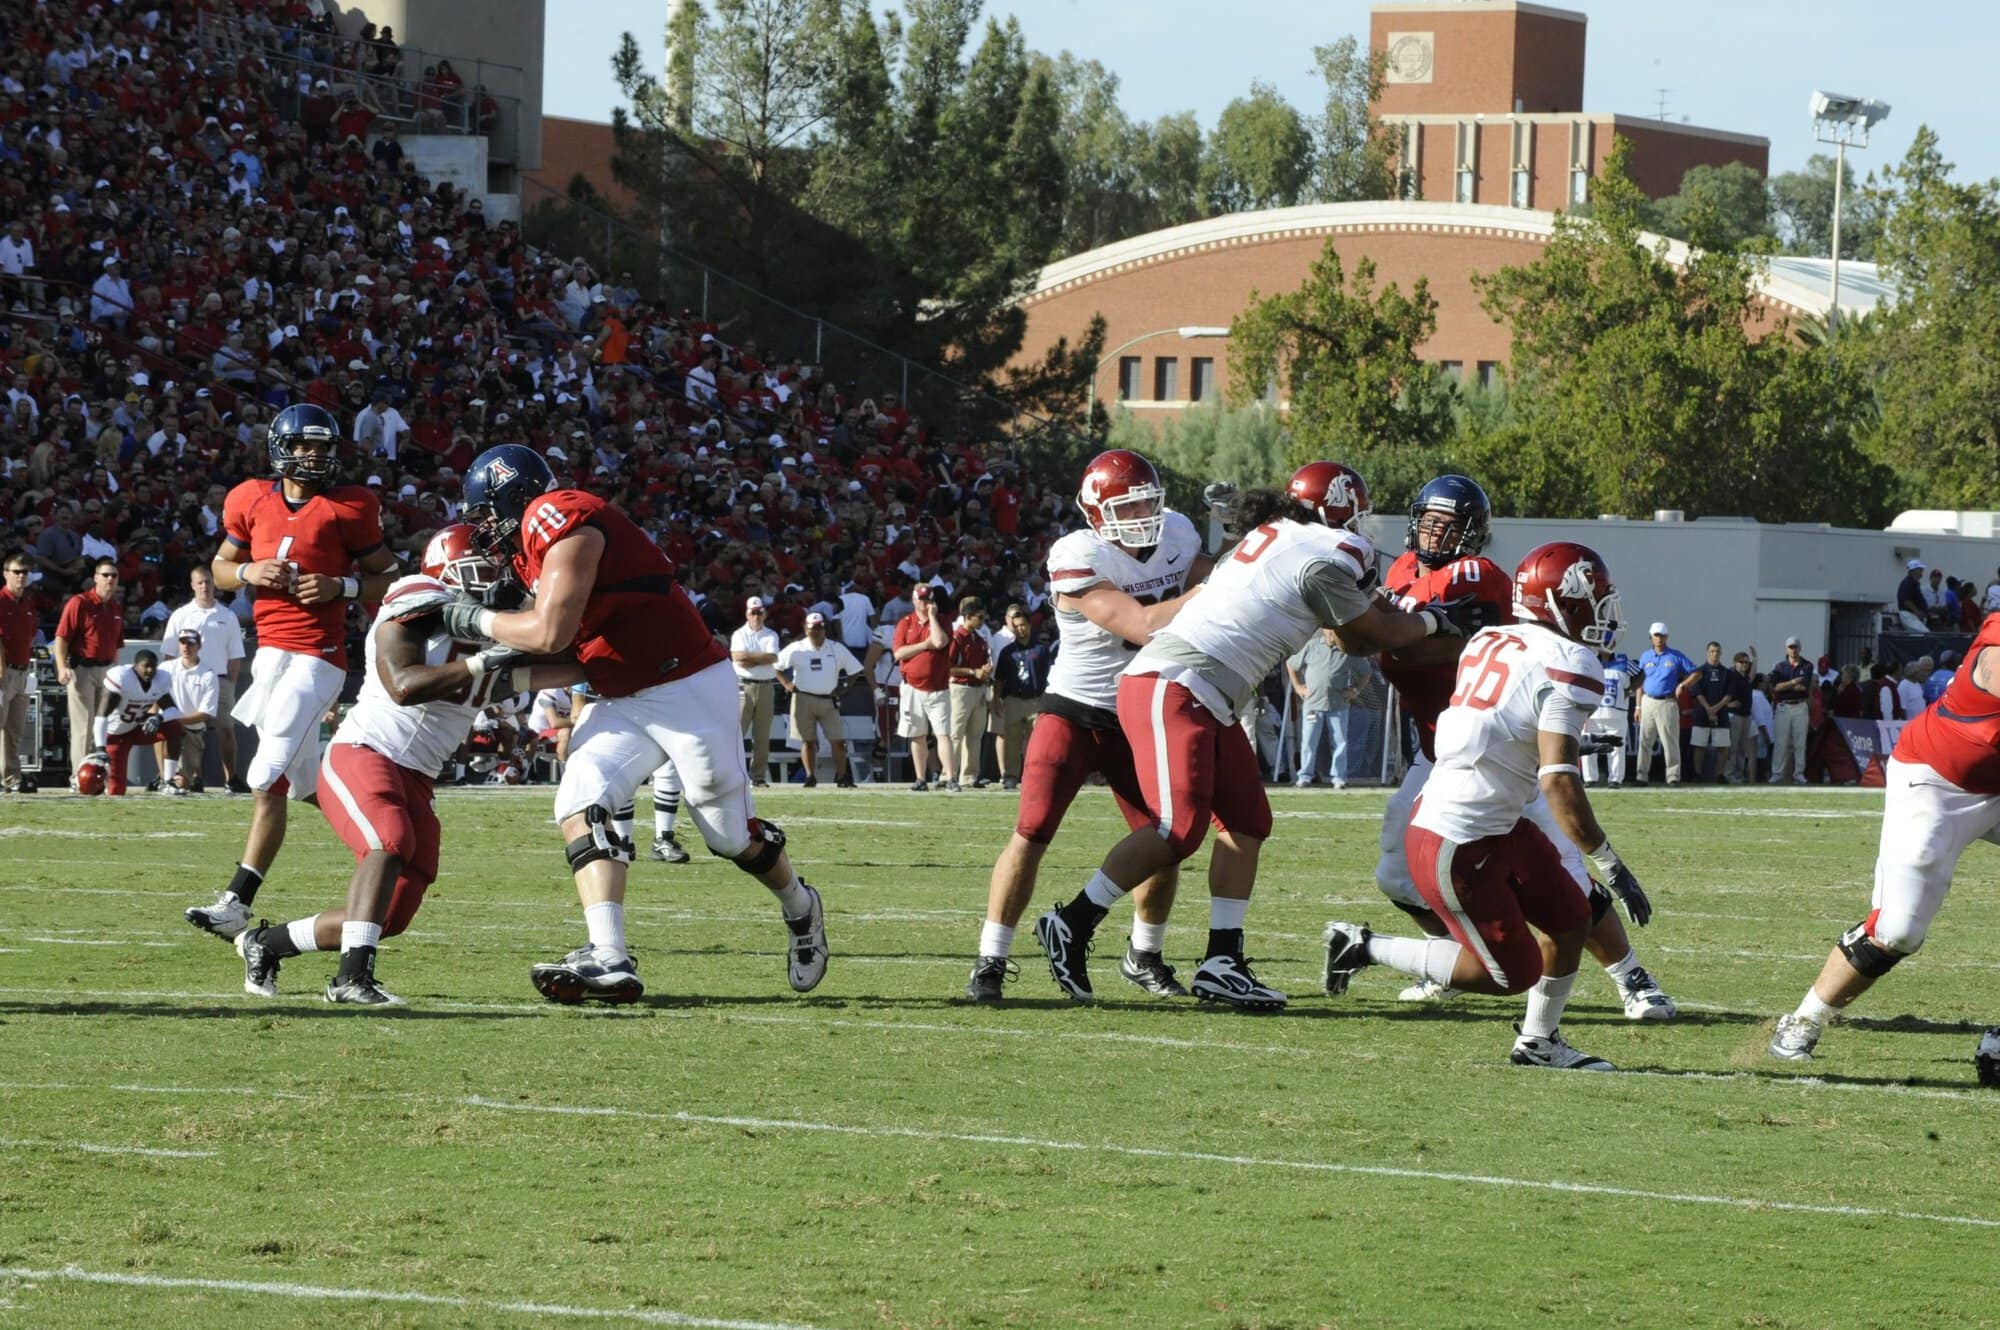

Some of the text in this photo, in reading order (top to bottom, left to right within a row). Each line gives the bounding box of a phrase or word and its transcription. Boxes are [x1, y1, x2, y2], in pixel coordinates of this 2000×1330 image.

[485, 456, 519, 490] A
[1122, 577, 1165, 593] WASHINGTON
[1448, 560, 1480, 585] 70
[1449, 631, 1528, 711] 26
